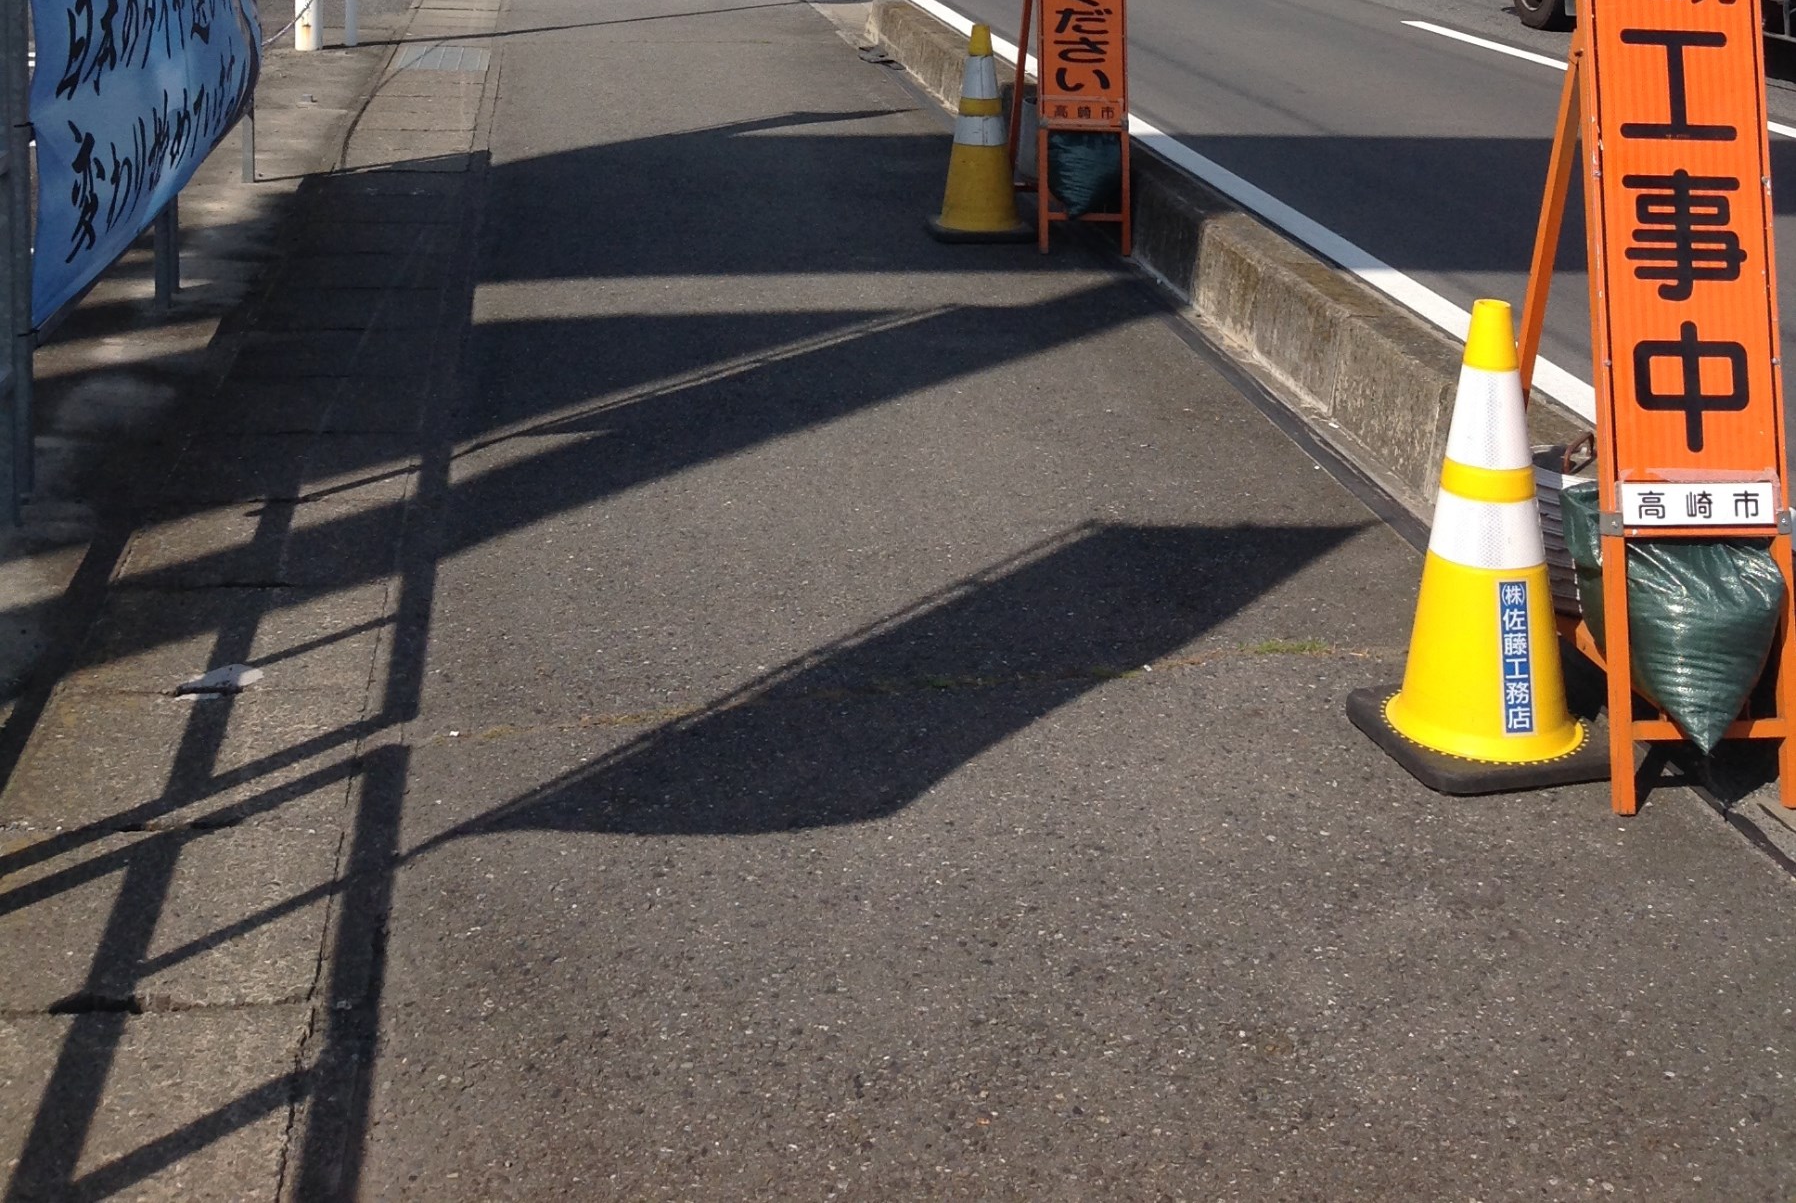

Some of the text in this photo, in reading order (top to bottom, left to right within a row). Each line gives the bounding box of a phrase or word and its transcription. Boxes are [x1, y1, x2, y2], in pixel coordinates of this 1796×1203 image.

[1052, 104, 1115, 120] 高崎市
[1619, 27, 1749, 454] 工事中
[1637, 489, 1760, 520] 高崎市
